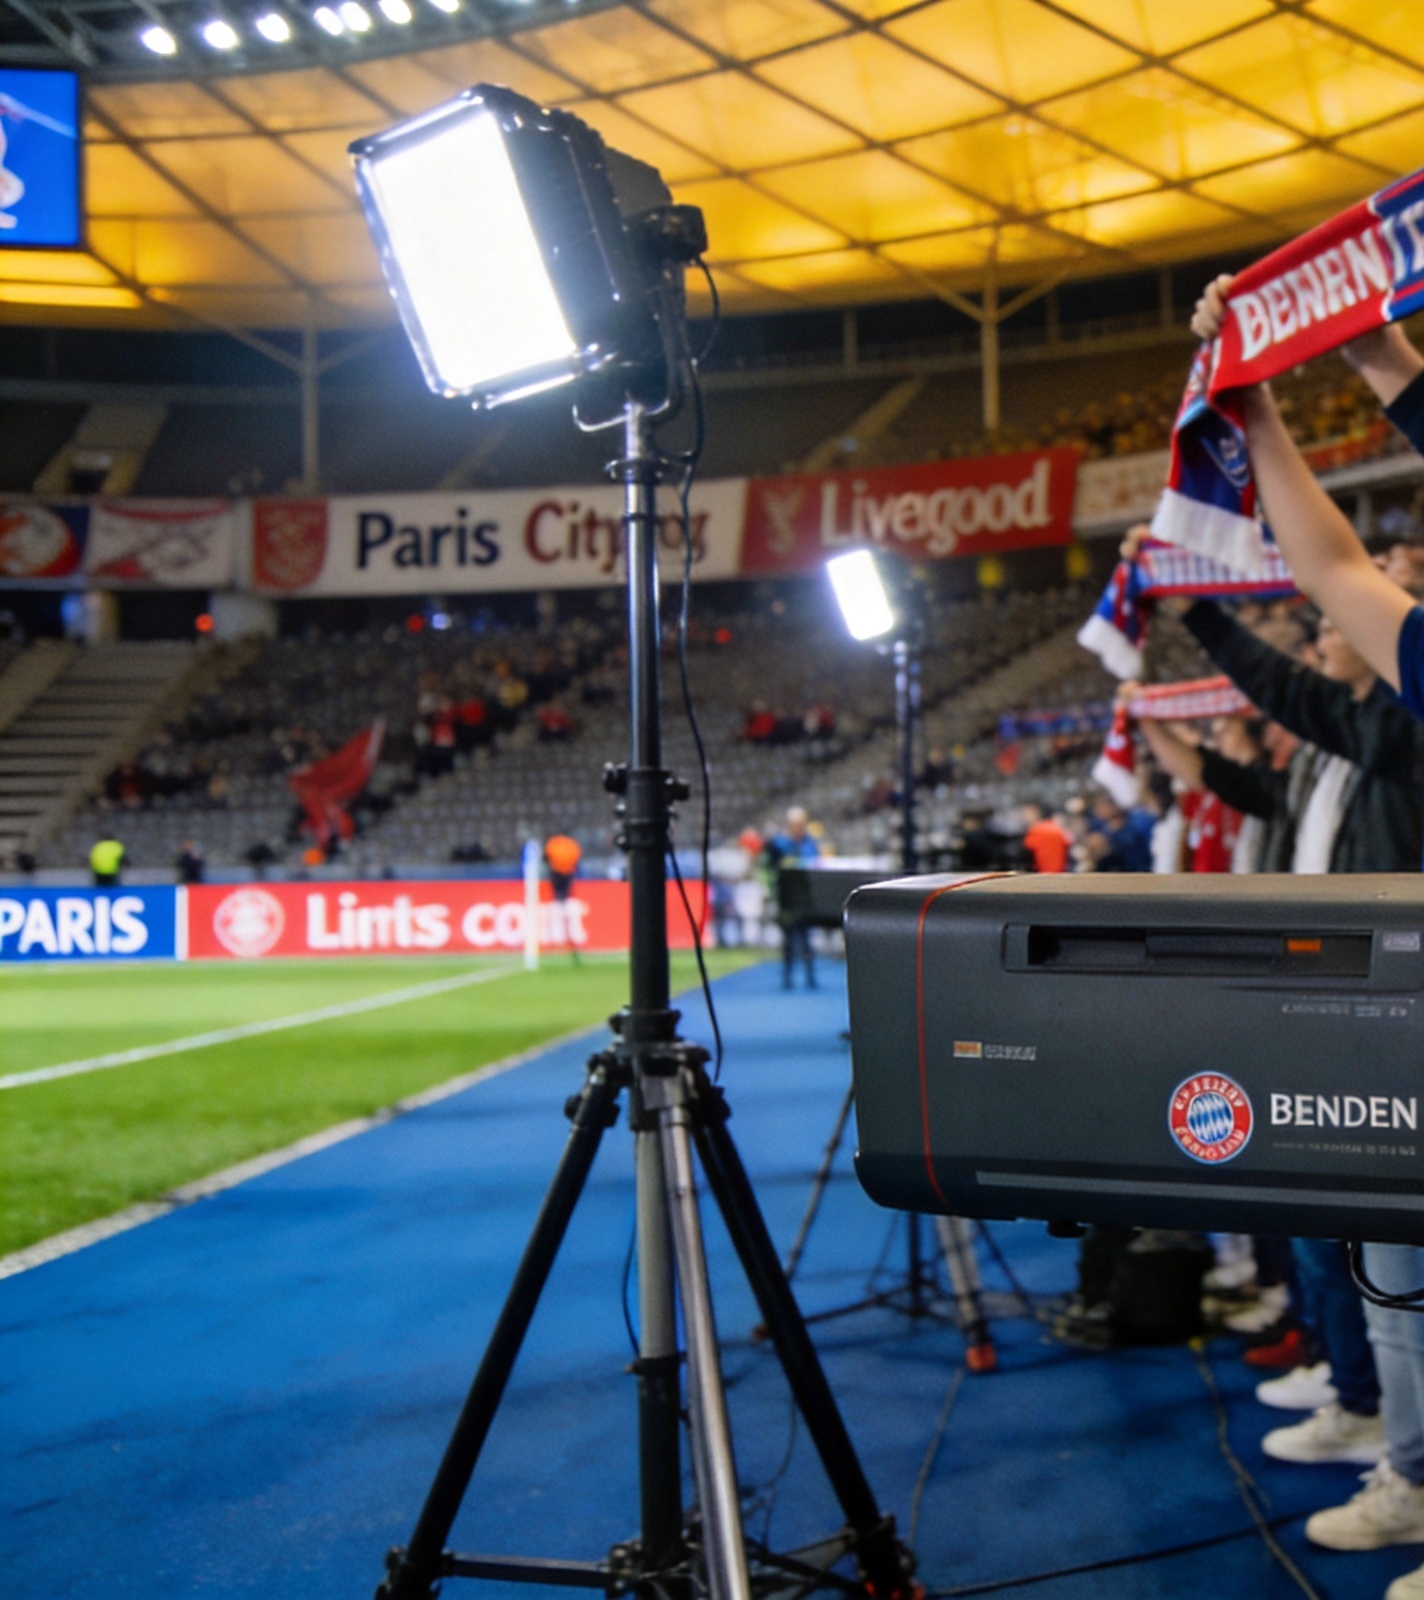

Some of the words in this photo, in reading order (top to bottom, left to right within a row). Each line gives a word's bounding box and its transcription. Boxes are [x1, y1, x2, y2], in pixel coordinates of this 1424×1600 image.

[355, 508, 500, 570] Paris
[0, 896, 148, 955] PARIS
[1270, 1093, 1417, 1130] BENDEN
